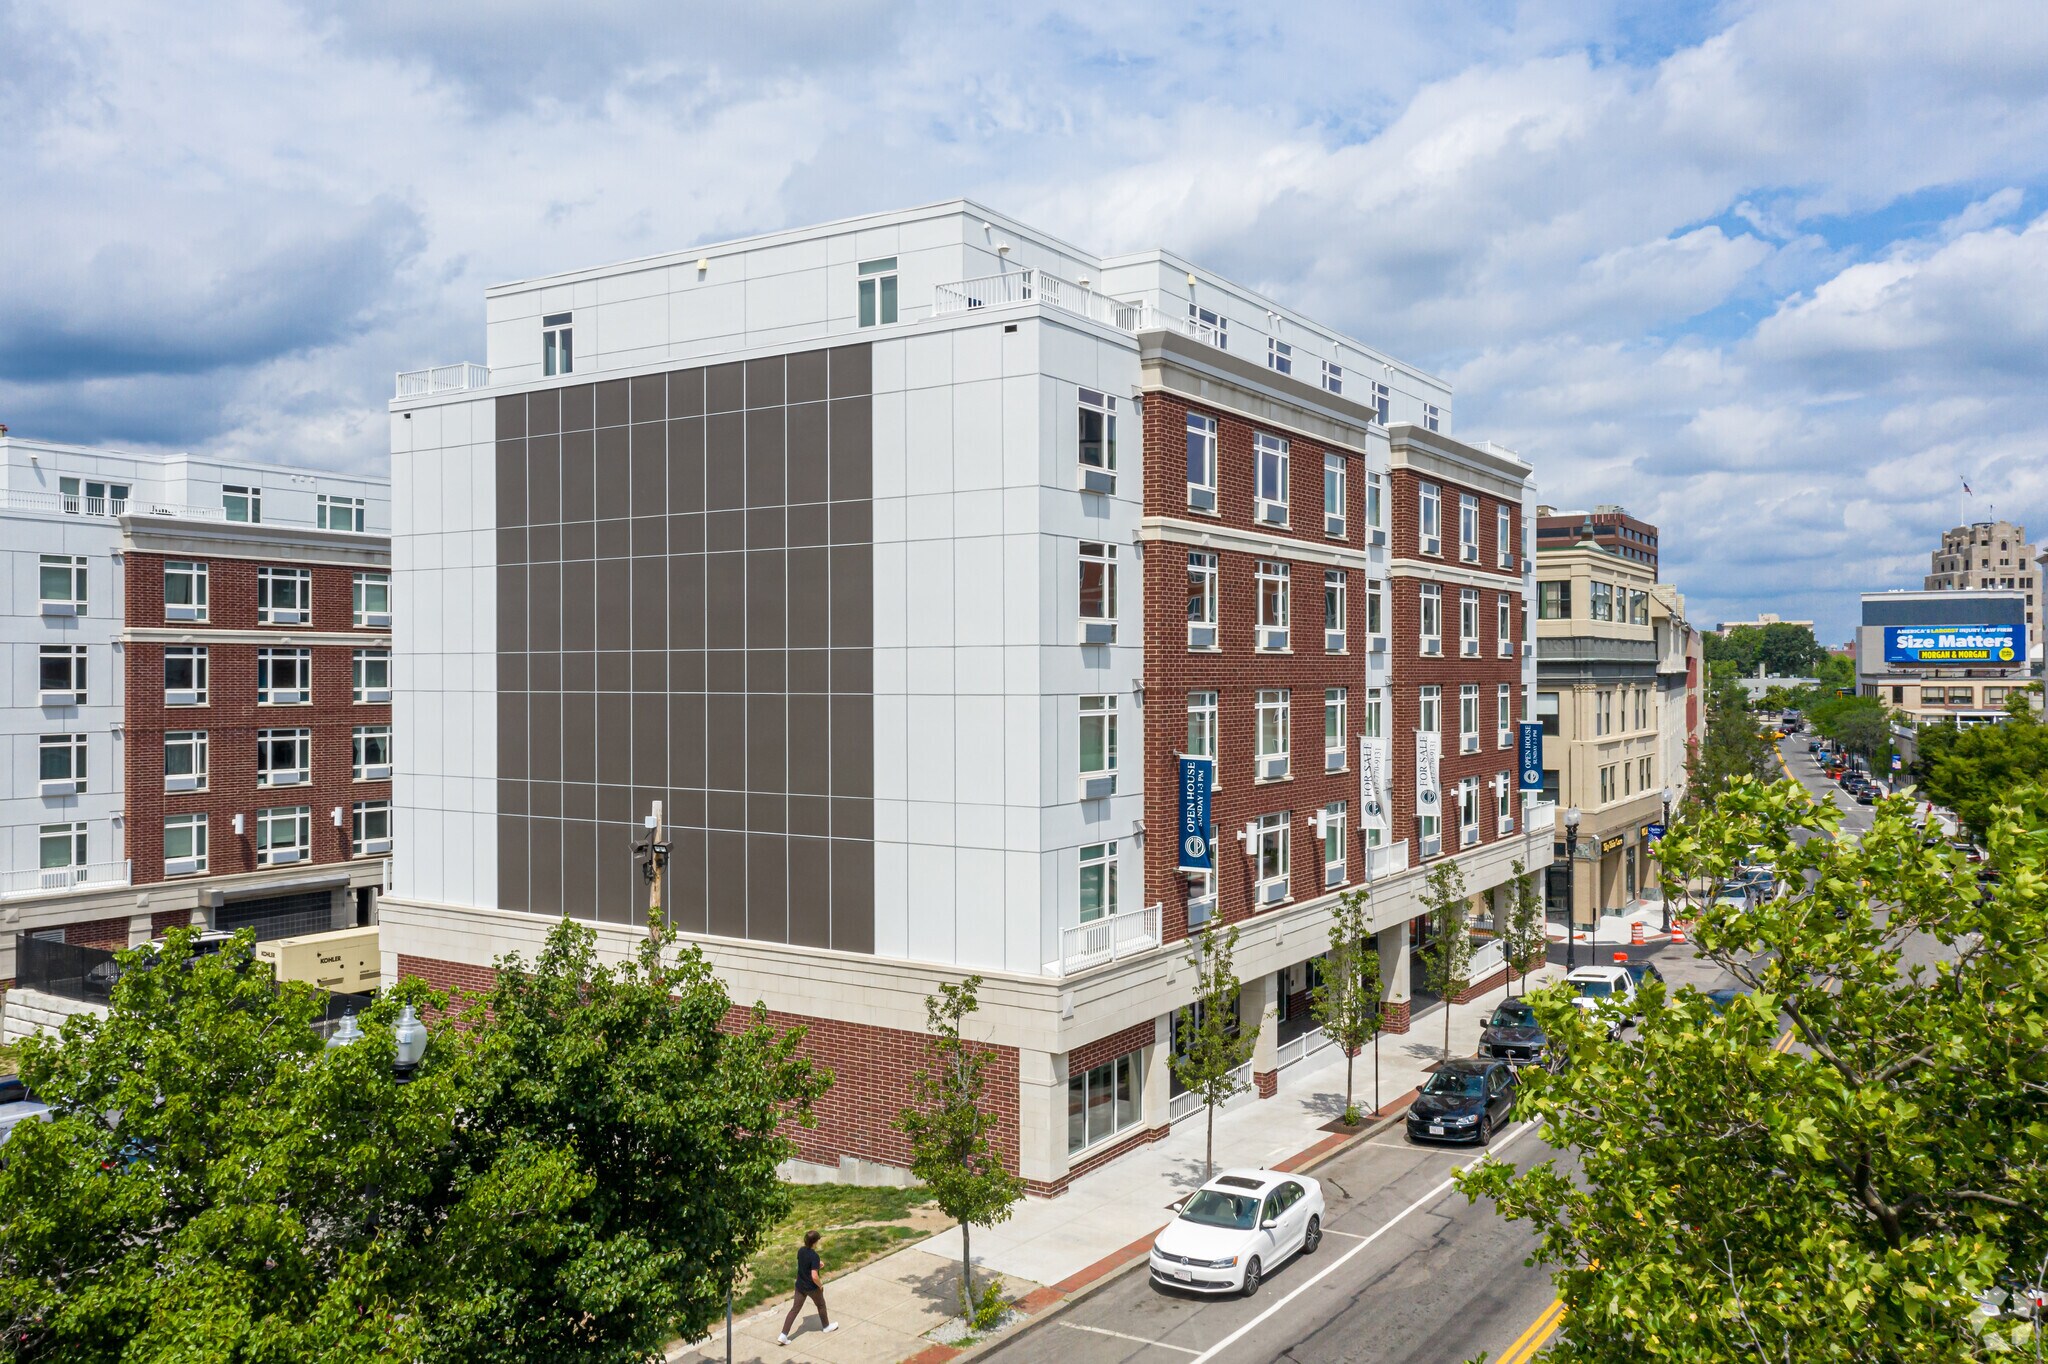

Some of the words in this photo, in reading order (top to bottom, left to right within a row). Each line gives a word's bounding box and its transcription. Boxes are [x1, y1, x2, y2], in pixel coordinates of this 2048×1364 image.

[1896, 634, 1935, 648] Size
[1938, 634, 2013, 648] Matters
[1921, 650, 1951, 659] MORGAN
[1951, 650, 1957, 658] &
[1958, 650, 1988, 659] MORGAN
[1363, 742, 1372, 772] SALE
[1419, 736, 1428, 763] SALE
[1186, 761, 1196, 800] HOUSE
[1197, 770, 1204, 782] PM
[1363, 775, 1372, 797] FOR
[1419, 766, 1428, 786] FOR
[1186, 802, 1196, 833] OPEN
[320, 955, 342, 964] KOHLER
